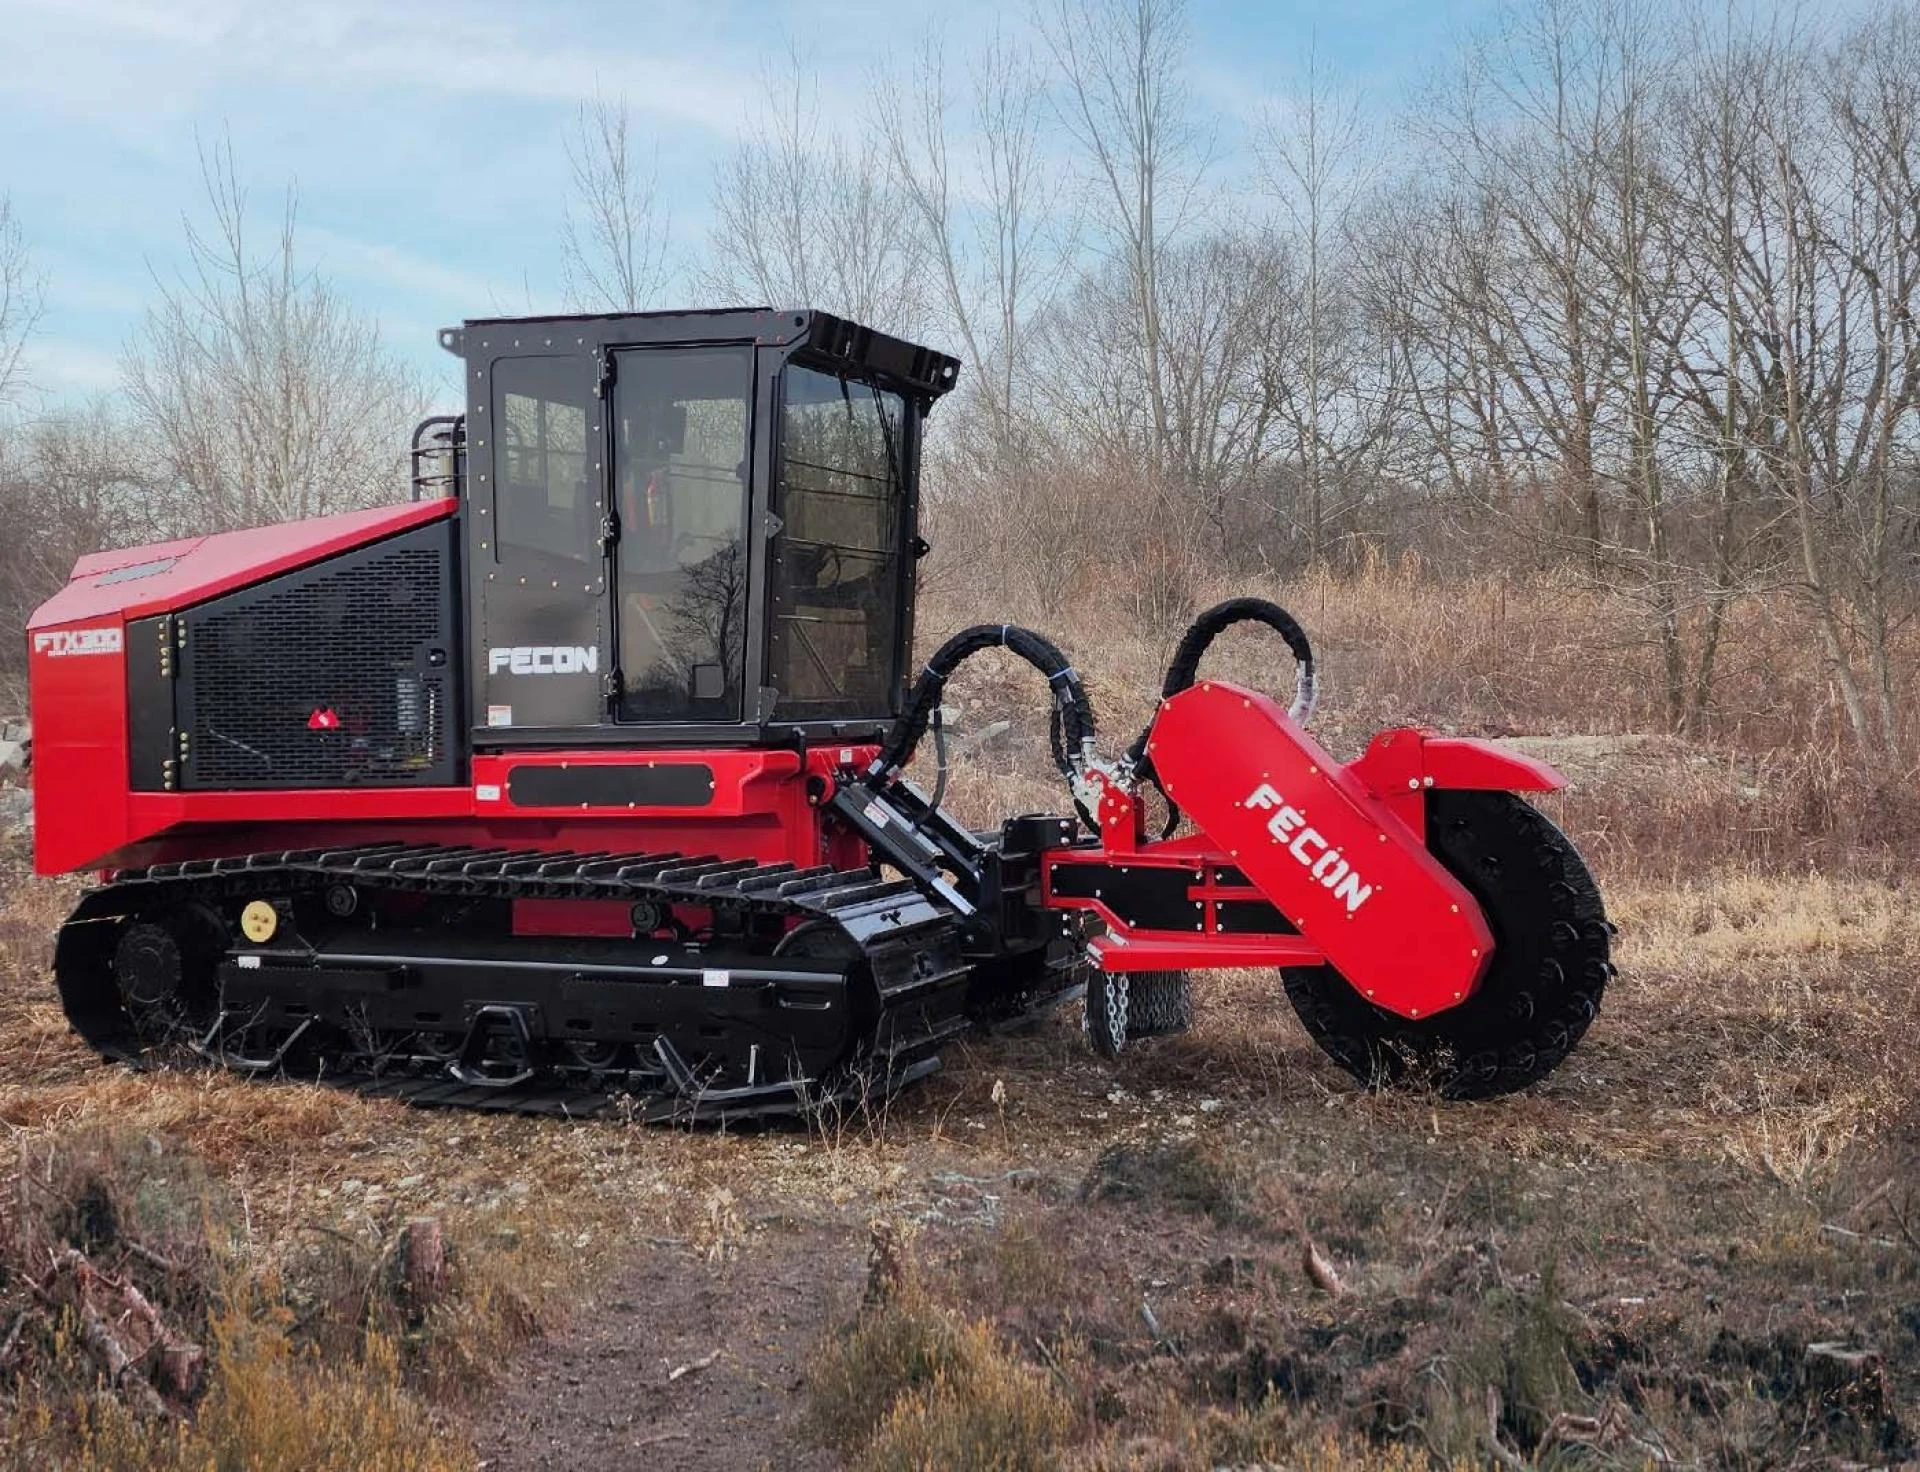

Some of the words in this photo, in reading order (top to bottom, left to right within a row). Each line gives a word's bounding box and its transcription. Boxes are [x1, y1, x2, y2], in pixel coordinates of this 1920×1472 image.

[34, 627, 122, 653] FTX300
[488, 646, 597, 674] FECON
[1244, 783, 1373, 911] FECON
